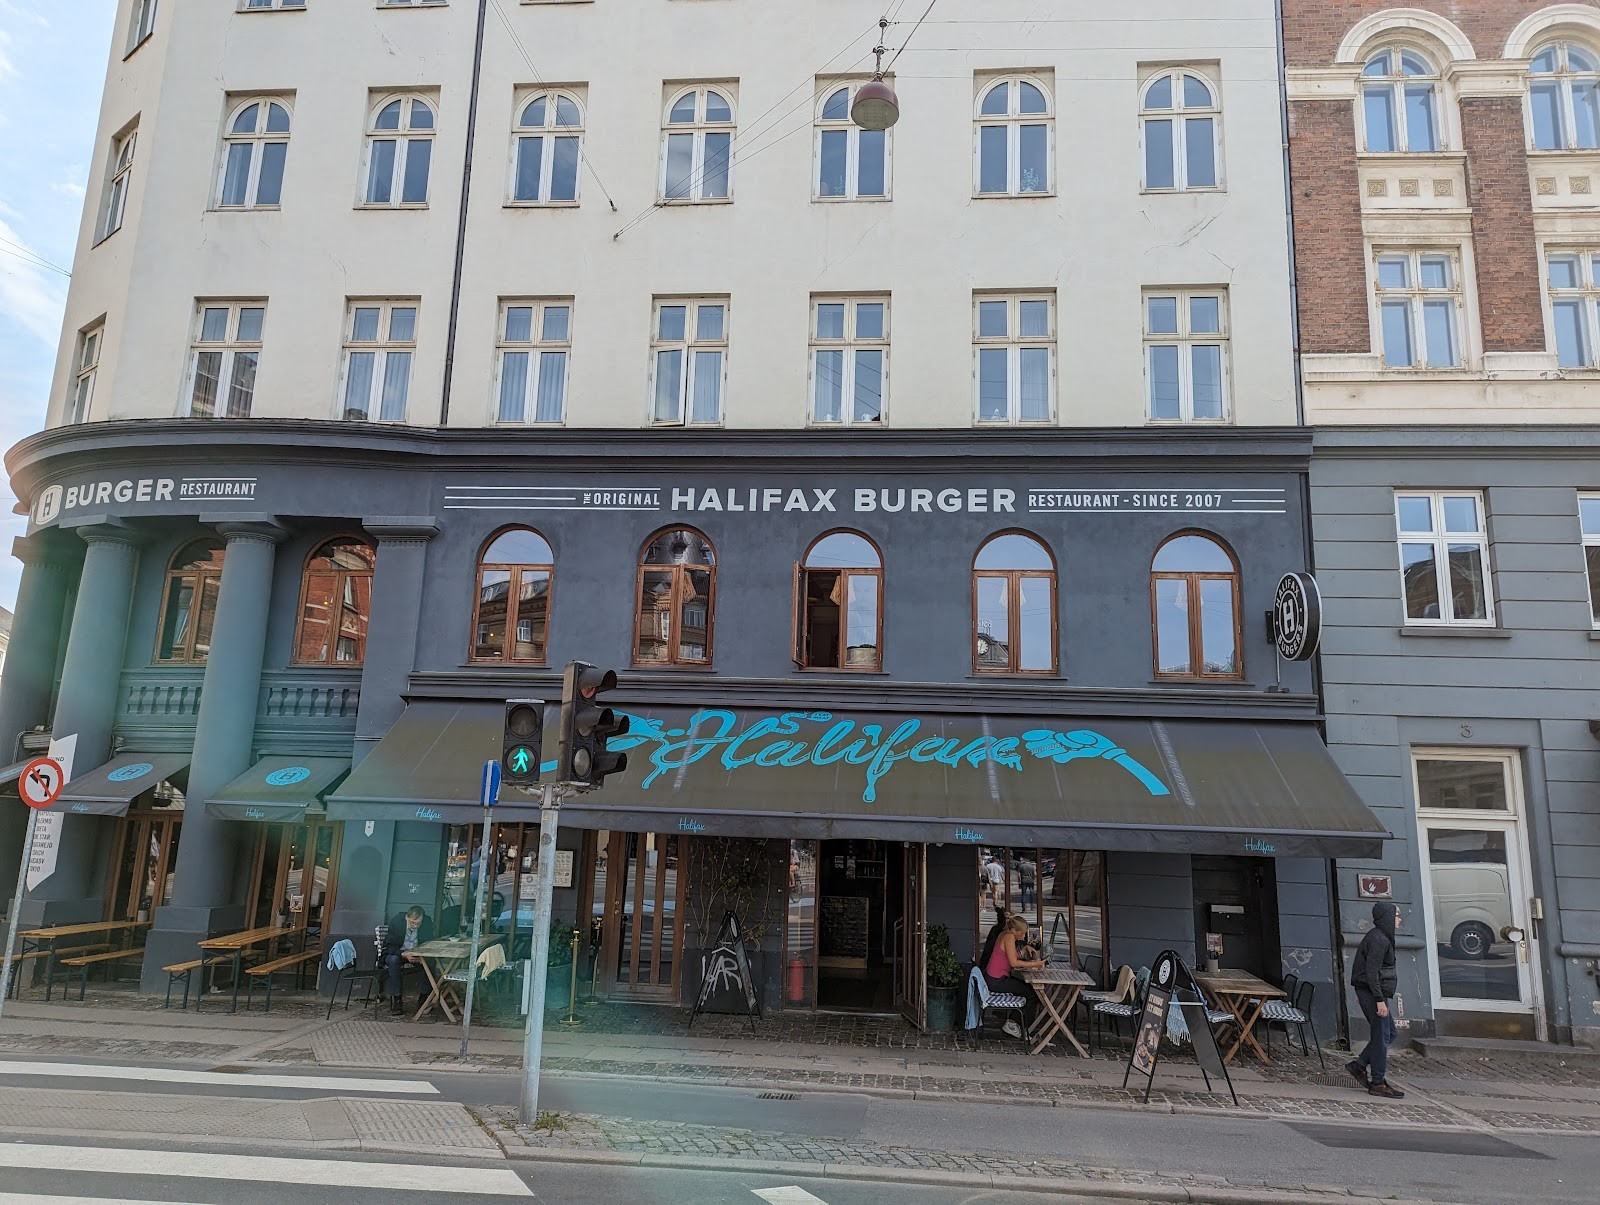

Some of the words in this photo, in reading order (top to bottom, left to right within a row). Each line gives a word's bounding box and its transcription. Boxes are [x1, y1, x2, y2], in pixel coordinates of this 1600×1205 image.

[64, 478, 175, 510] BURGER
[180, 482, 257, 496] RESTAURANT
[583, 492, 592, 505] THE
[593, 492, 661, 506] ORIGINAL
[671, 487, 837, 512] HALIFAX
[854, 487, 1016, 513] BURGER
[1028, 494, 1120, 508] RESTAURANT
[1132, 494, 1179, 508] SINCE
[1185, 494, 1222, 508] 2007
[1276, 578, 1300, 608] HALIFAX
[1282, 598, 1295, 635] H
[1278, 623, 1303, 656] BURGERS
[1460, 722, 1473, 739] 3
[641, 708, 1023, 803] Halifax
[245, 806, 265, 819] Halifax
[415, 806, 442, 821] Halifax
[678, 816, 706, 834] Halifax
[954, 826, 984, 843] Halifax
[1243, 836, 1276, 855] Halifax
